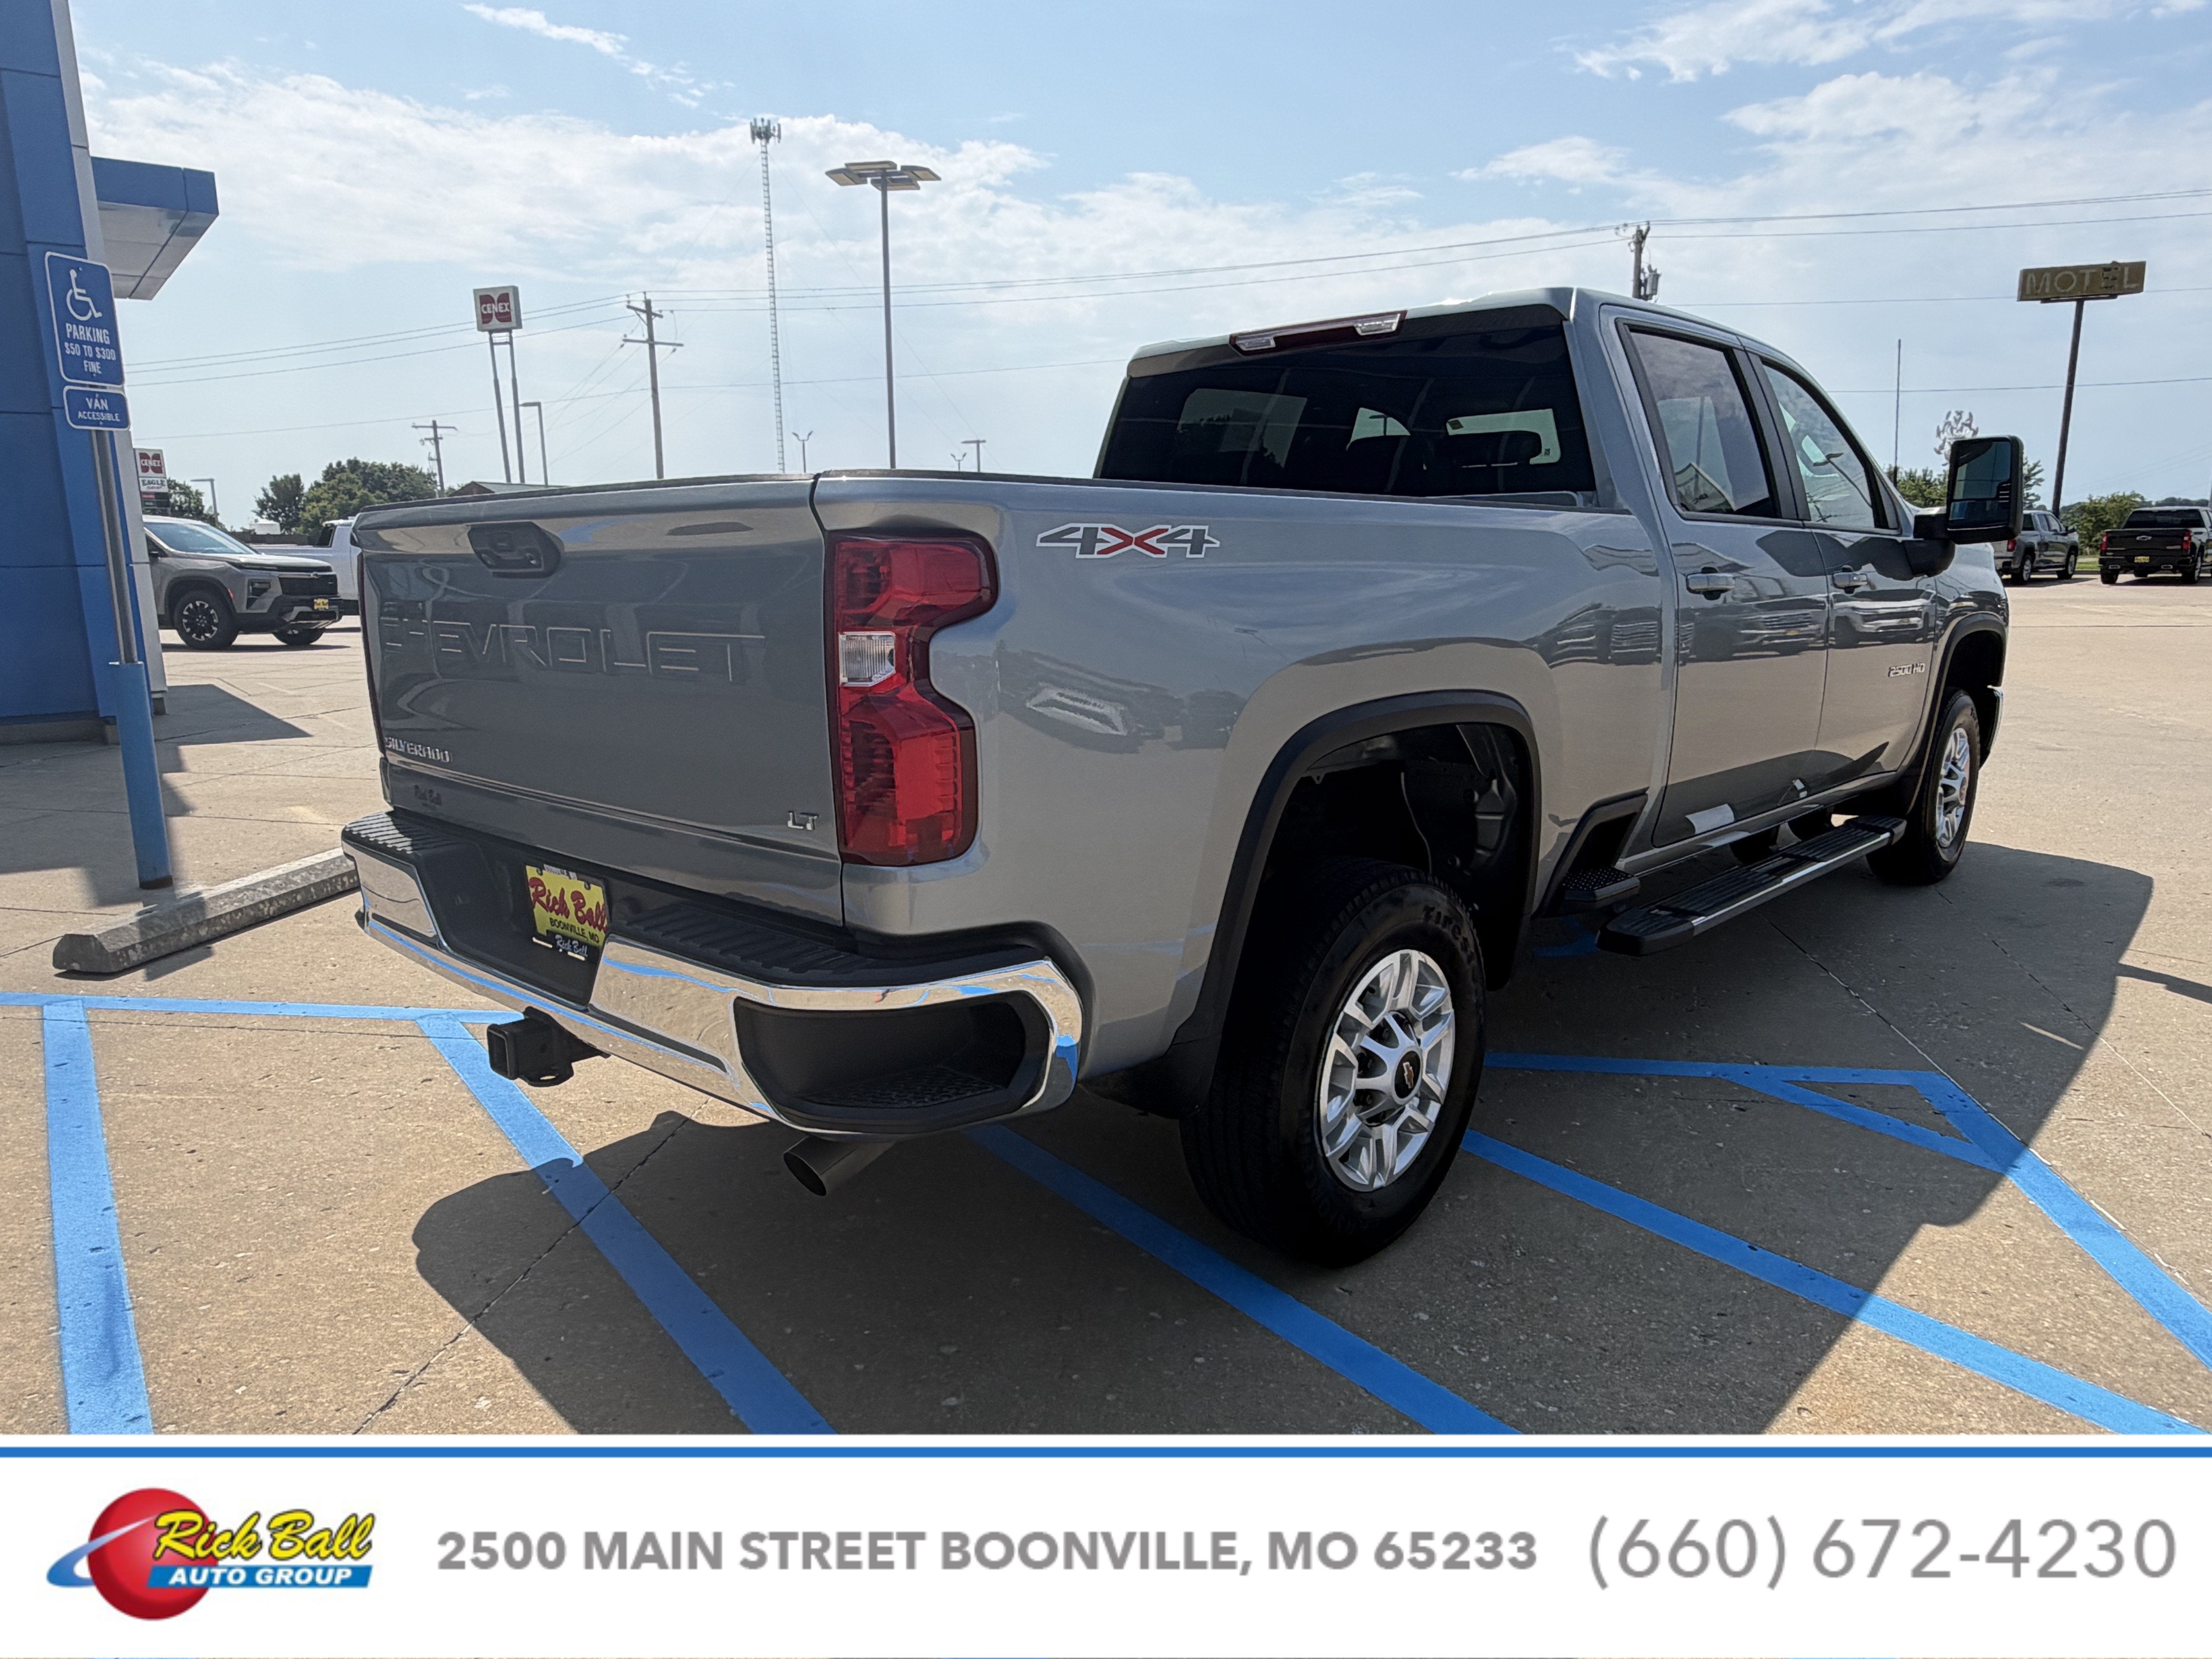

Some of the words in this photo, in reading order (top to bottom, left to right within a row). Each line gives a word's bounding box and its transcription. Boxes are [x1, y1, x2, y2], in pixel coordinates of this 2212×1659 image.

[2026, 266, 2138, 294] MOTEL
[481, 302, 510, 314] CENEX
[65, 322, 111, 345] PARKING
[64, 342, 81, 356] $50
[82, 345, 93, 357] TO
[95, 347, 116, 361] $300
[83, 360, 102, 374] FINE
[85, 397, 109, 410] VAN
[78, 411, 120, 422] ACCESSIBLE
[384, 737, 452, 763] SILVERADO
[787, 810, 819, 831] LT
[529, 877, 570, 919] Rick
[570, 890, 608, 934] Ball
[555, 934, 572, 951] Rick
[572, 940, 588, 957] Ball
[589, 931, 600, 943] MO
